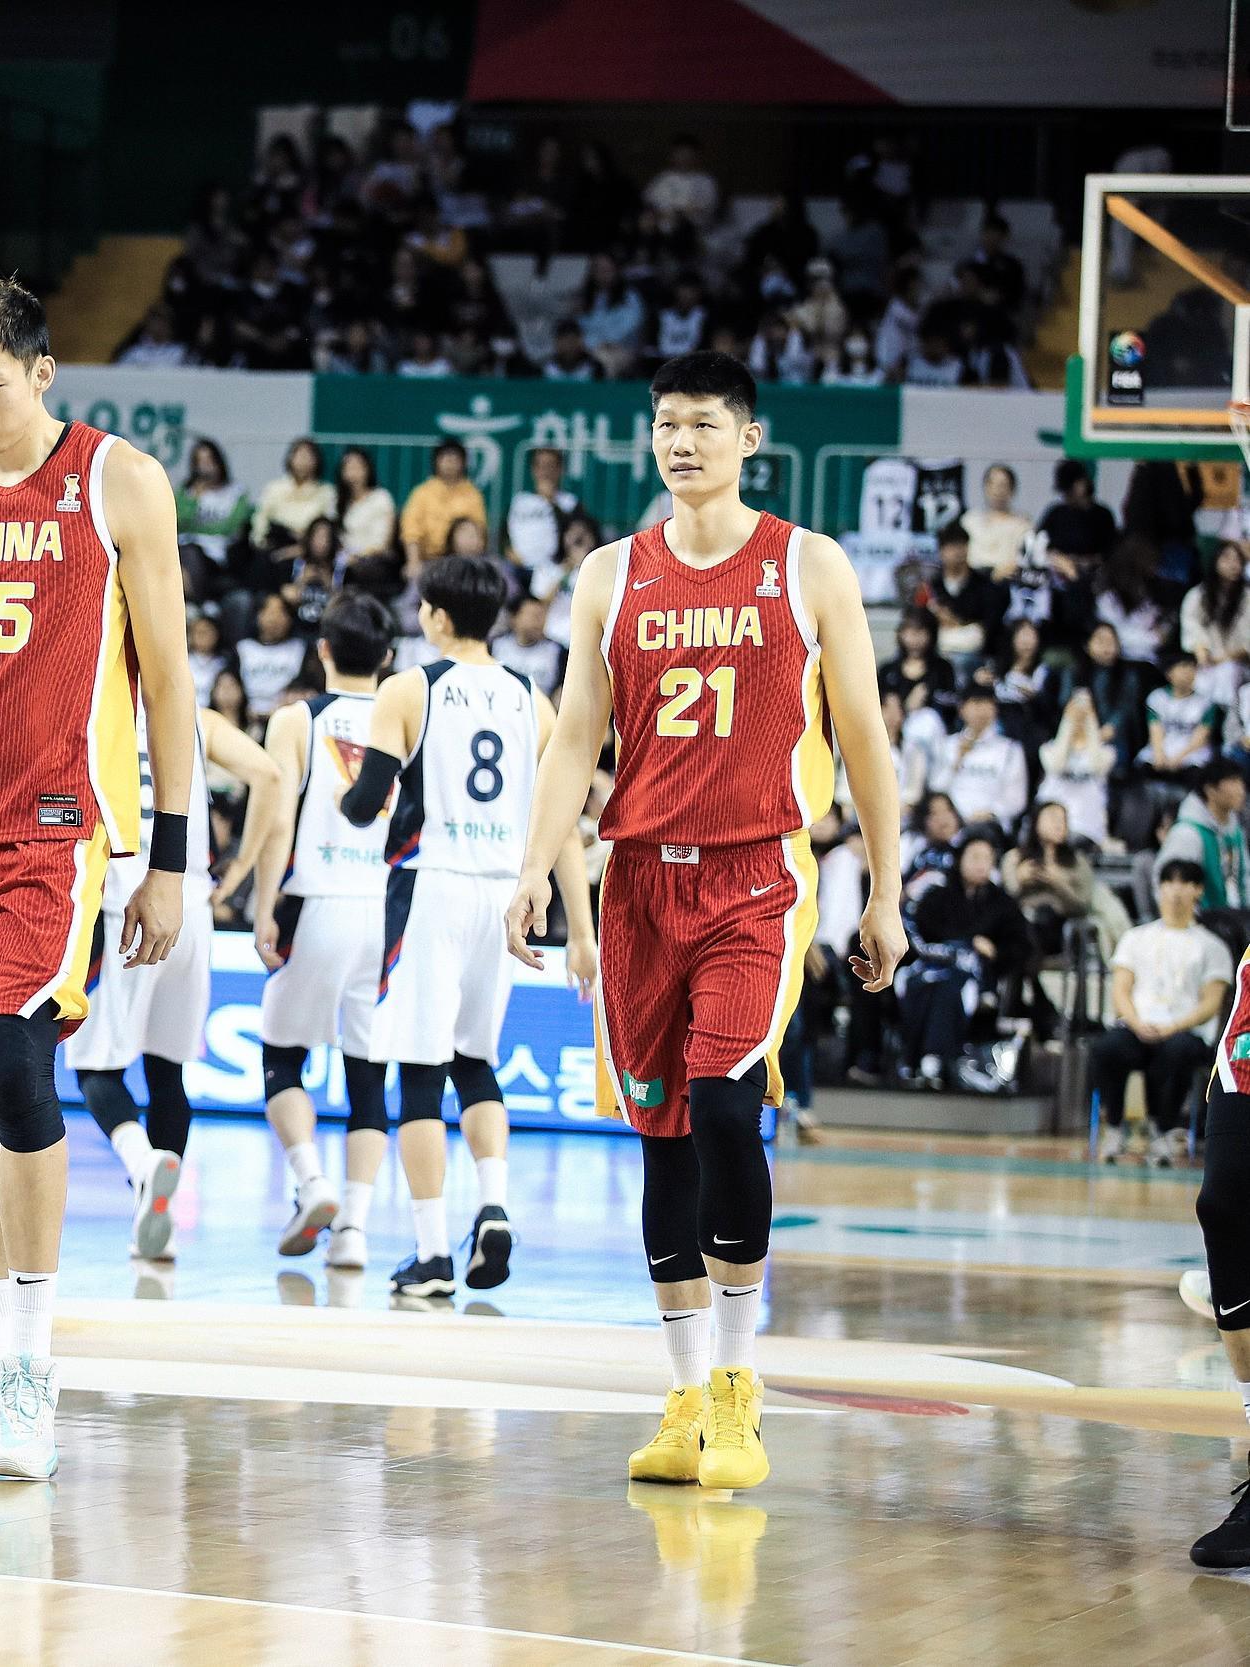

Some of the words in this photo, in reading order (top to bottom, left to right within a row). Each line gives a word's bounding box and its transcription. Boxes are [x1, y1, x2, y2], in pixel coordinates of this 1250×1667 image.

[637, 606, 764, 651] CHINA
[443, 686, 469, 707] AN
[485, 690, 495, 710] Y
[656, 666, 736, 738] 21
[466, 730, 504, 802] 8
[64, 812, 75, 821] 54
